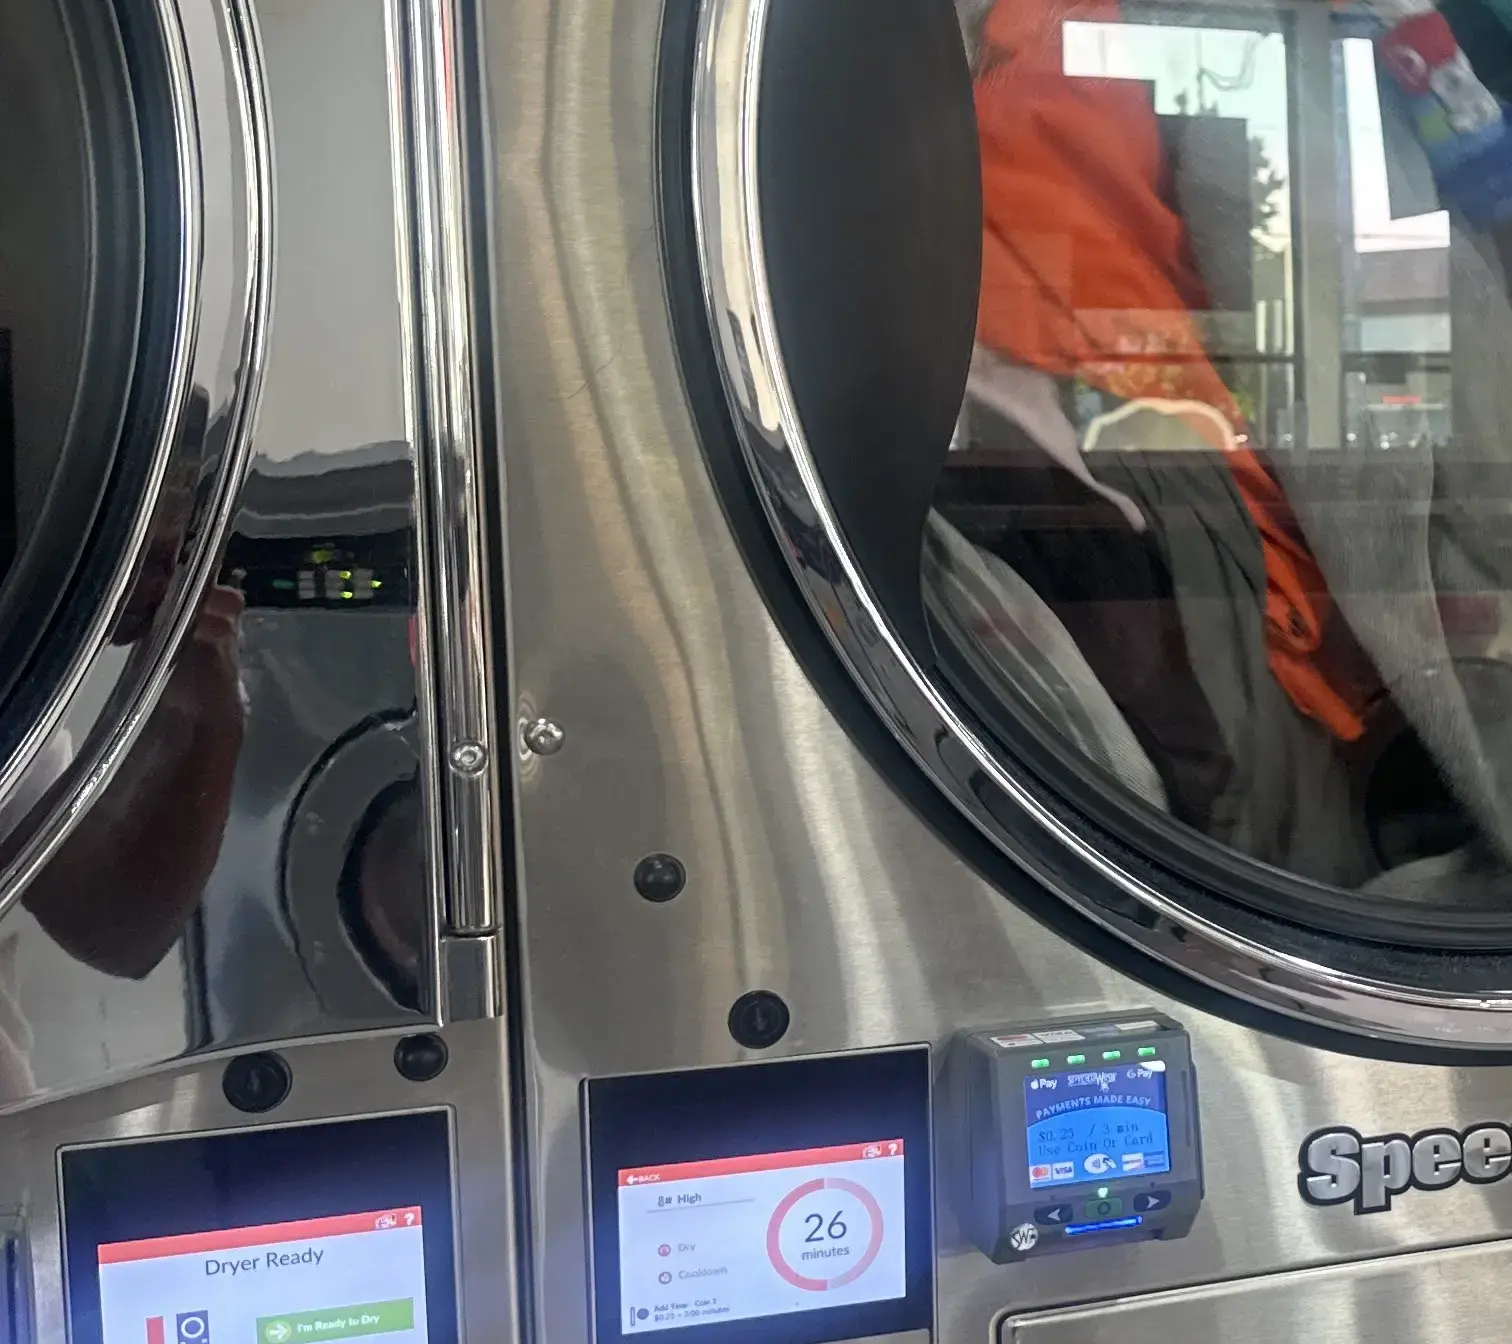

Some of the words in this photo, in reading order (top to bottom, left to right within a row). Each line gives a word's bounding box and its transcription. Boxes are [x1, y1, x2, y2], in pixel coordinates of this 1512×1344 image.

[1137, 1067, 1154, 1080] Pay
[1040, 1077, 1058, 1090] Pay
[1036, 1096, 1091, 1119] PAYMENTS
[1094, 1094, 1123, 1105] MADE
[1126, 1094, 1152, 1106] EASY
[1103, 1123, 1110, 1135] 3
[1116, 1121, 1139, 1134] min
[1038, 1144, 1061, 1156] Use
[1067, 1141, 1097, 1154] Coin
[1103, 1137, 1116, 1148] Or
[1124, 1131, 1153, 1145] Card
[1055, 1165, 1073, 1175] VISA
[638, 1173, 661, 1183] BACK
[677, 1192, 702, 1206] High
[804, 1210, 848, 1243] 26
[801, 1245, 850, 1261] minutes
[205, 1257, 260, 1276] Dryer
[266, 1247, 324, 1269] Ready
[297, 1323, 313, 1333] I'm
[315, 1318, 347, 1331] Ready
[348, 1317, 360, 1326] to
[361, 1315, 380, 1325] Dry
